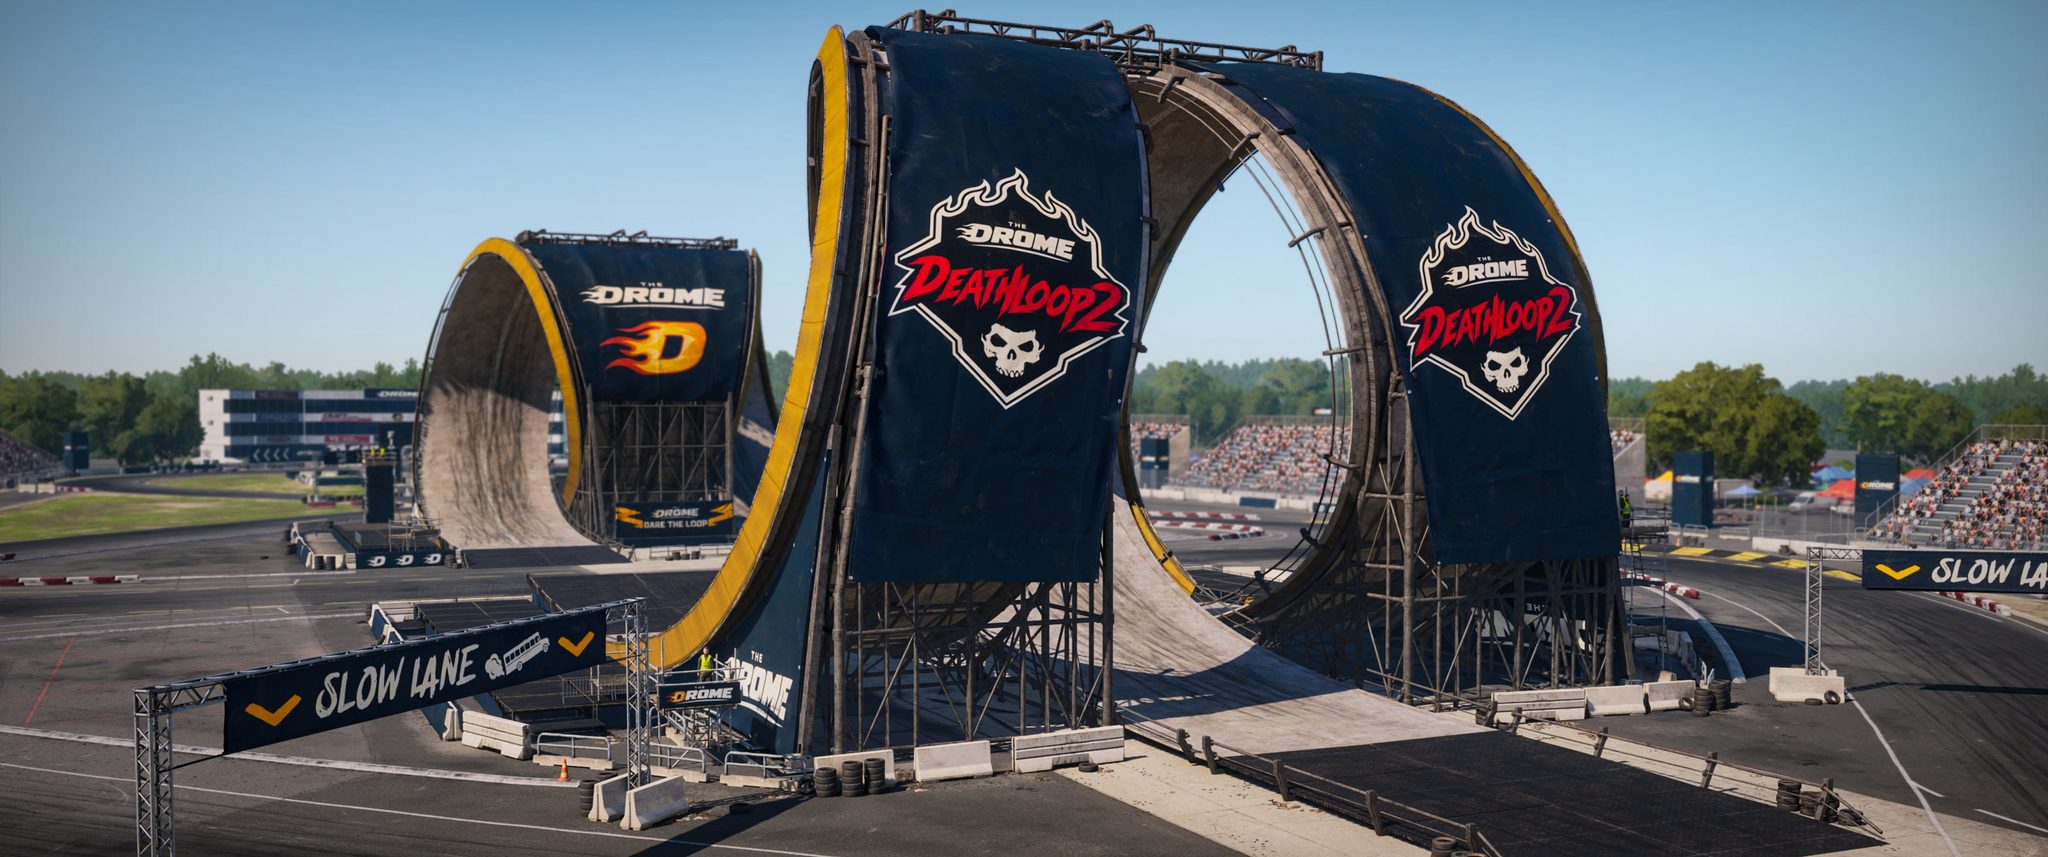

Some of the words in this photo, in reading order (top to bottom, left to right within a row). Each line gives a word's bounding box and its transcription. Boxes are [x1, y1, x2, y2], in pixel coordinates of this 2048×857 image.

[1008, 221, 1027, 230] THE
[956, 223, 1075, 260] DROME
[1441, 259, 1529, 286] DROME
[579, 285, 725, 307] DROME
[652, 508, 699, 518] DROME
[644, 521, 665, 529] DARE
[1931, 558, 2015, 584] SLOW
[751, 650, 763, 664] THE
[315, 656, 405, 719] SLOW
[410, 644, 479, 699] LANE
[666, 687, 734, 703] DROME
